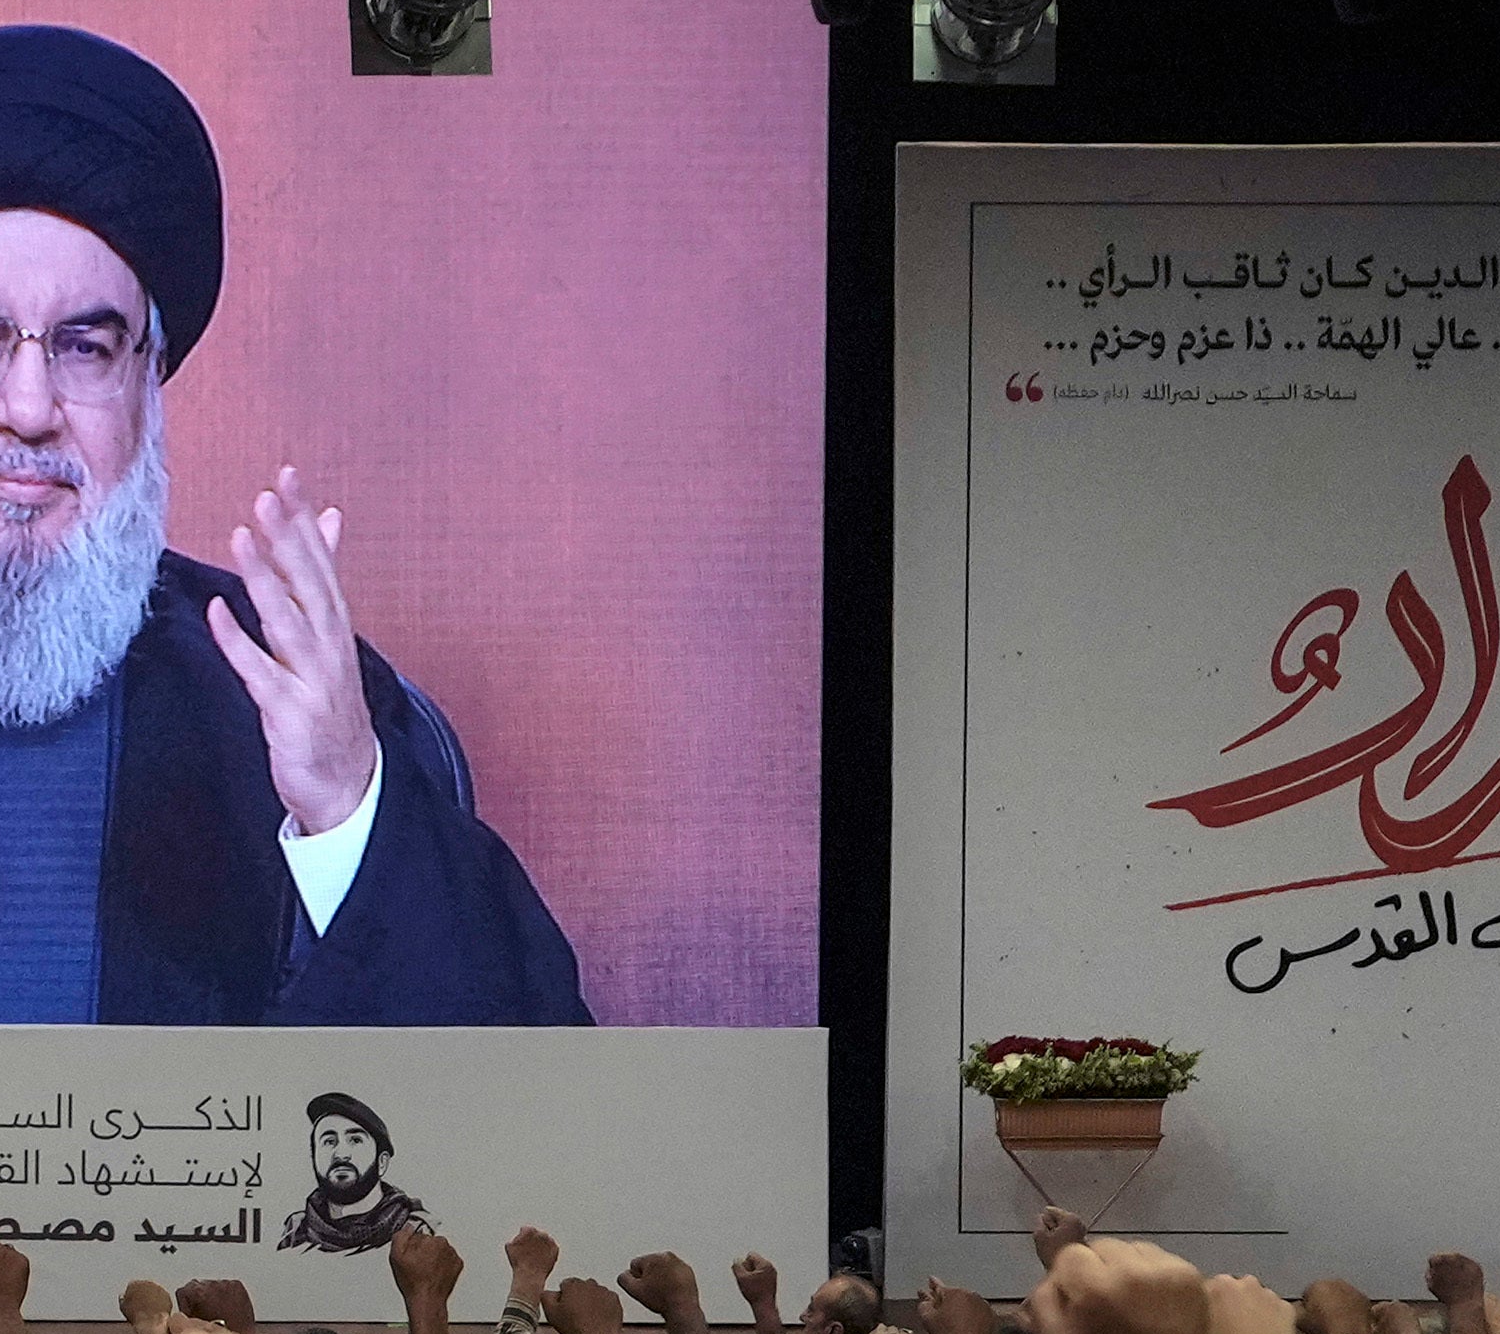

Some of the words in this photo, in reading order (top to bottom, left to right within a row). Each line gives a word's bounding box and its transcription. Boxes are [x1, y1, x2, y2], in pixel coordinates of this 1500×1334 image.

[1079, 243, 1171, 308] الرأي
[1183, 250, 1291, 300] ثاقب
[1300, 254, 1374, 298] كان
[1385, 254, 1498, 299] الدين
[1090, 325, 1165, 366] وحزم
[1177, 324, 1235, 365] عزم
[1245, 316, 1272, 350] ذا
[1413, 316, 1481, 370] عالي
[1205, 388, 1249, 405] حسن
[1303, 383, 1357, 401] سماحة
[1225, 889, 1458, 994] القدس
[89, 1094, 263, 1140] الذكرى
[57, 1151, 263, 1198] لإستشهاد
[134, 1207, 262, 1254] السيد
